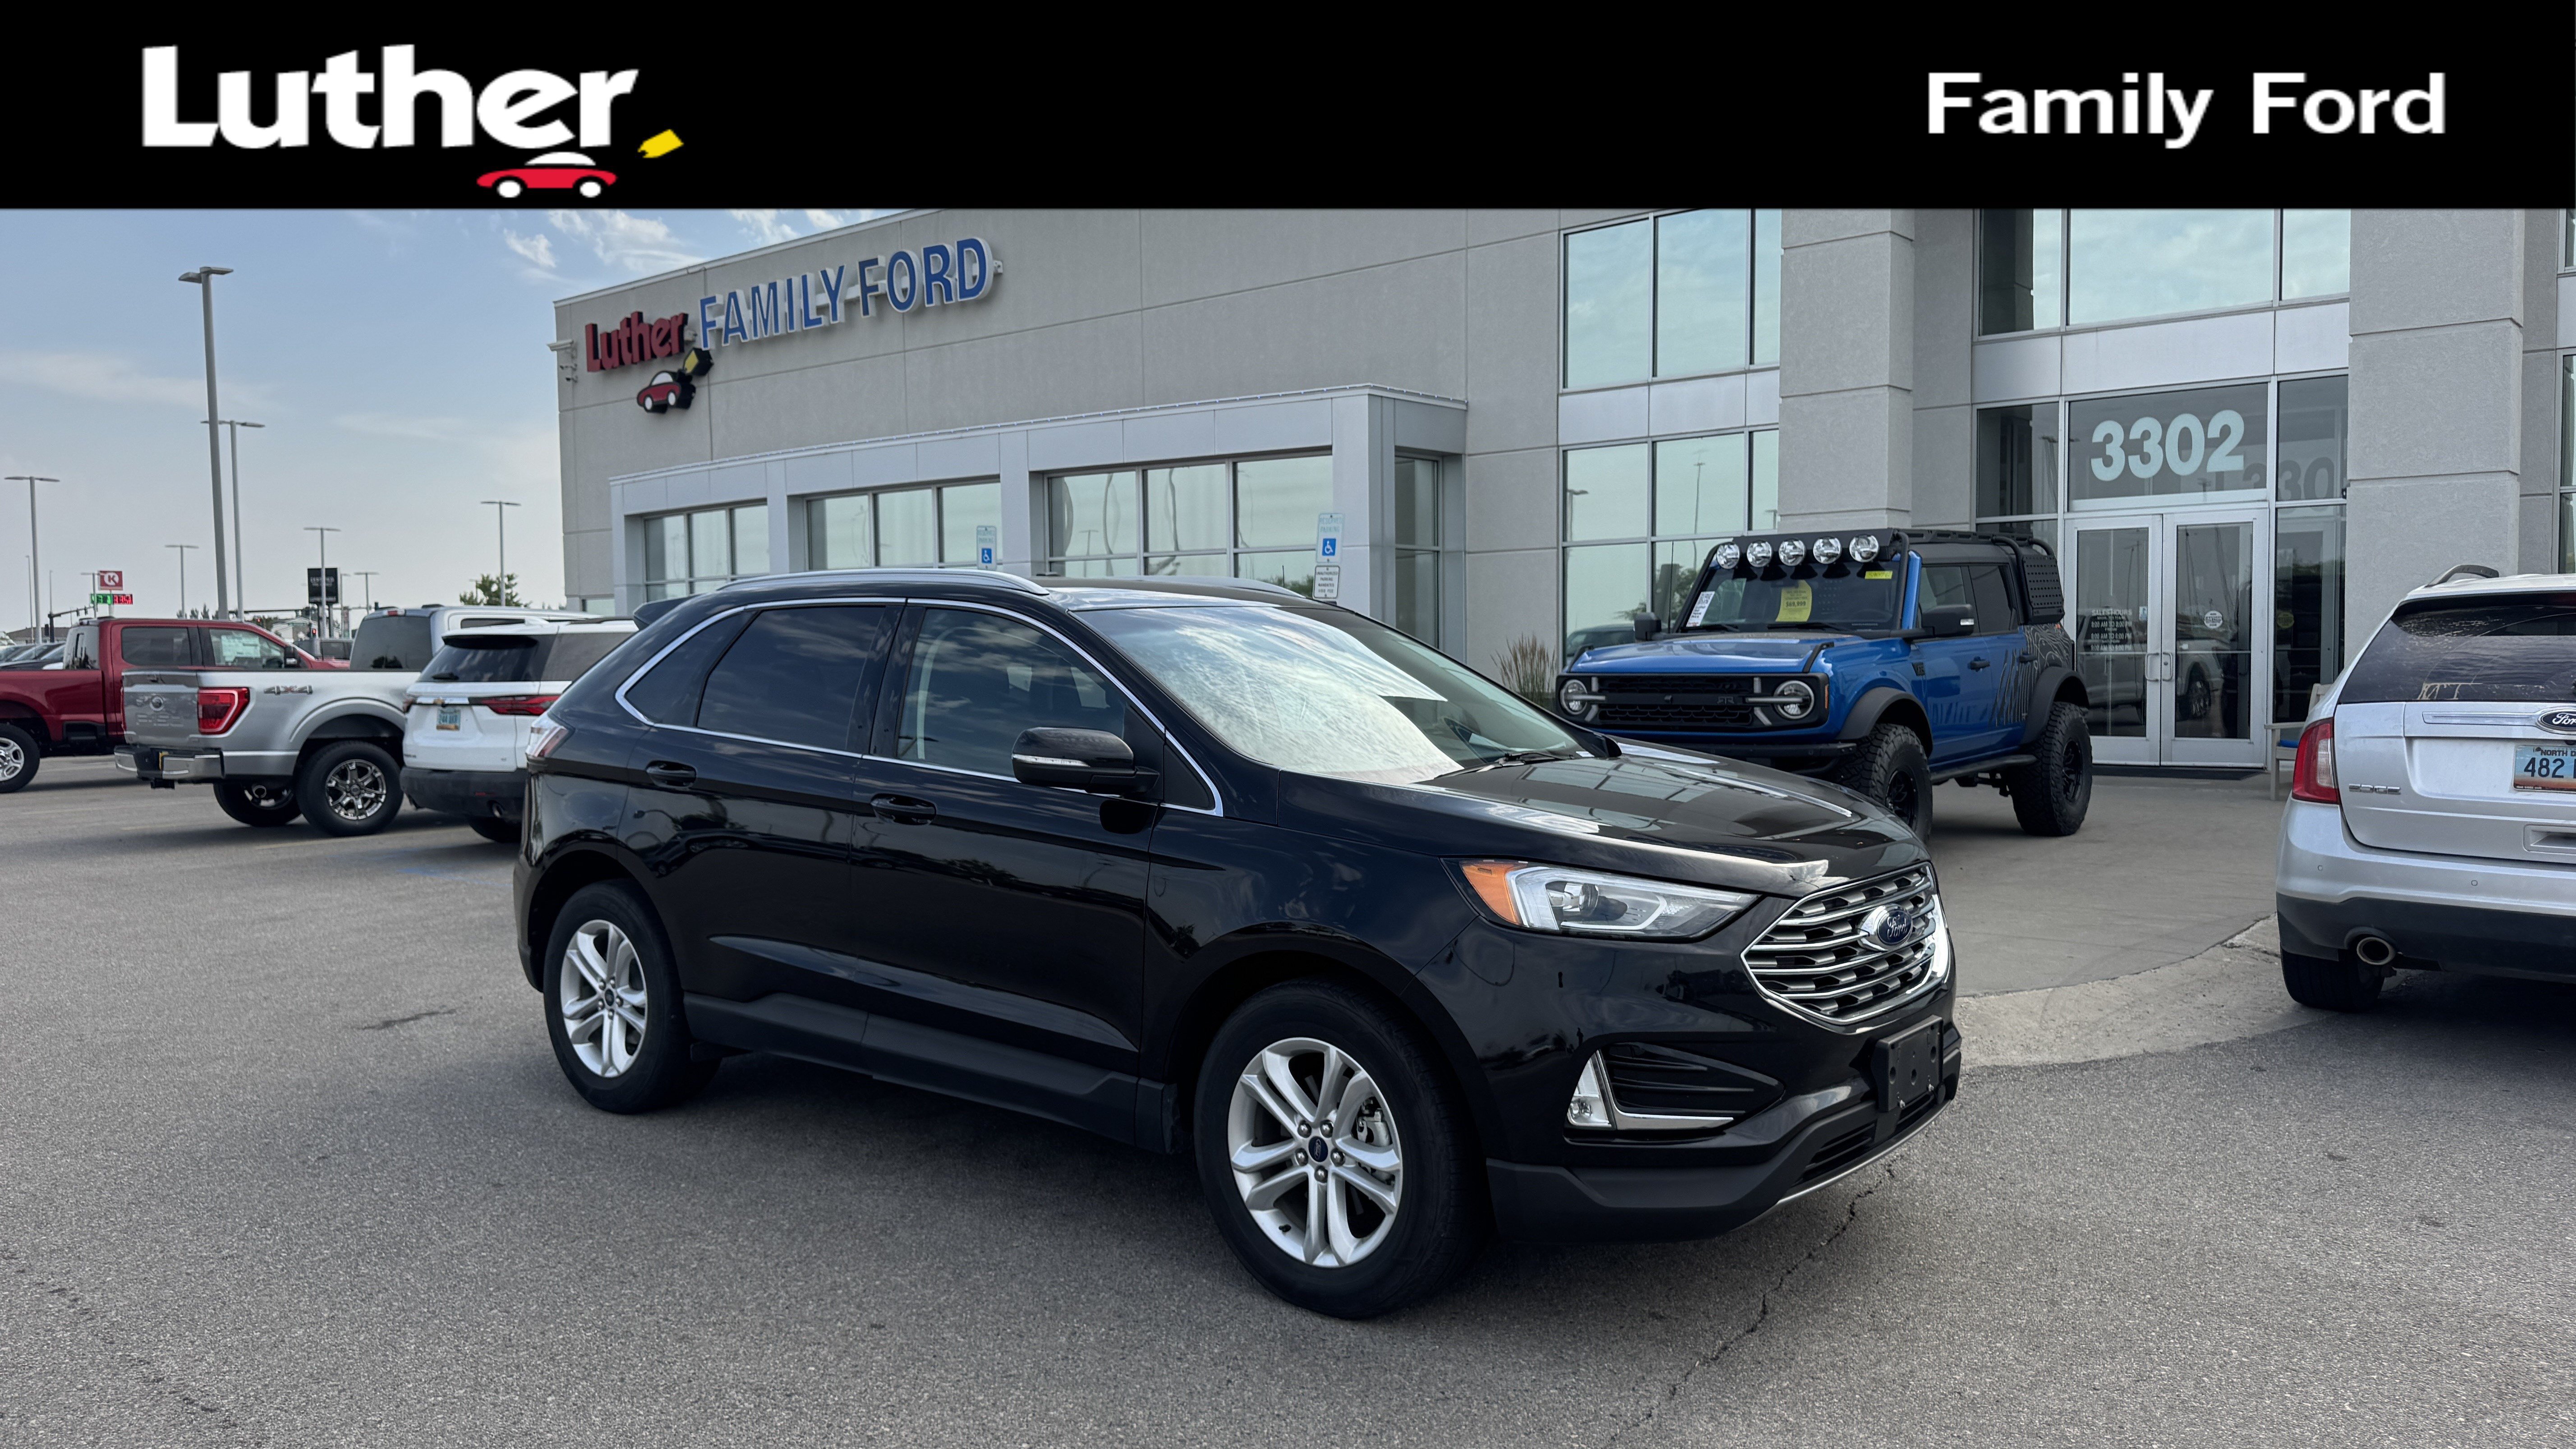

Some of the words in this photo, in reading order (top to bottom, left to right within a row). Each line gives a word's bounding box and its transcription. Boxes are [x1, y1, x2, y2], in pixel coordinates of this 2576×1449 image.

[699, 264, 846, 351] FAMILY
[858, 237, 992, 318] FORD
[585, 311, 689, 372] Luther
[2091, 409, 2244, 481] 3302
[2524, 757, 2565, 778] 482
[1887, 913, 1908, 940] Ford
